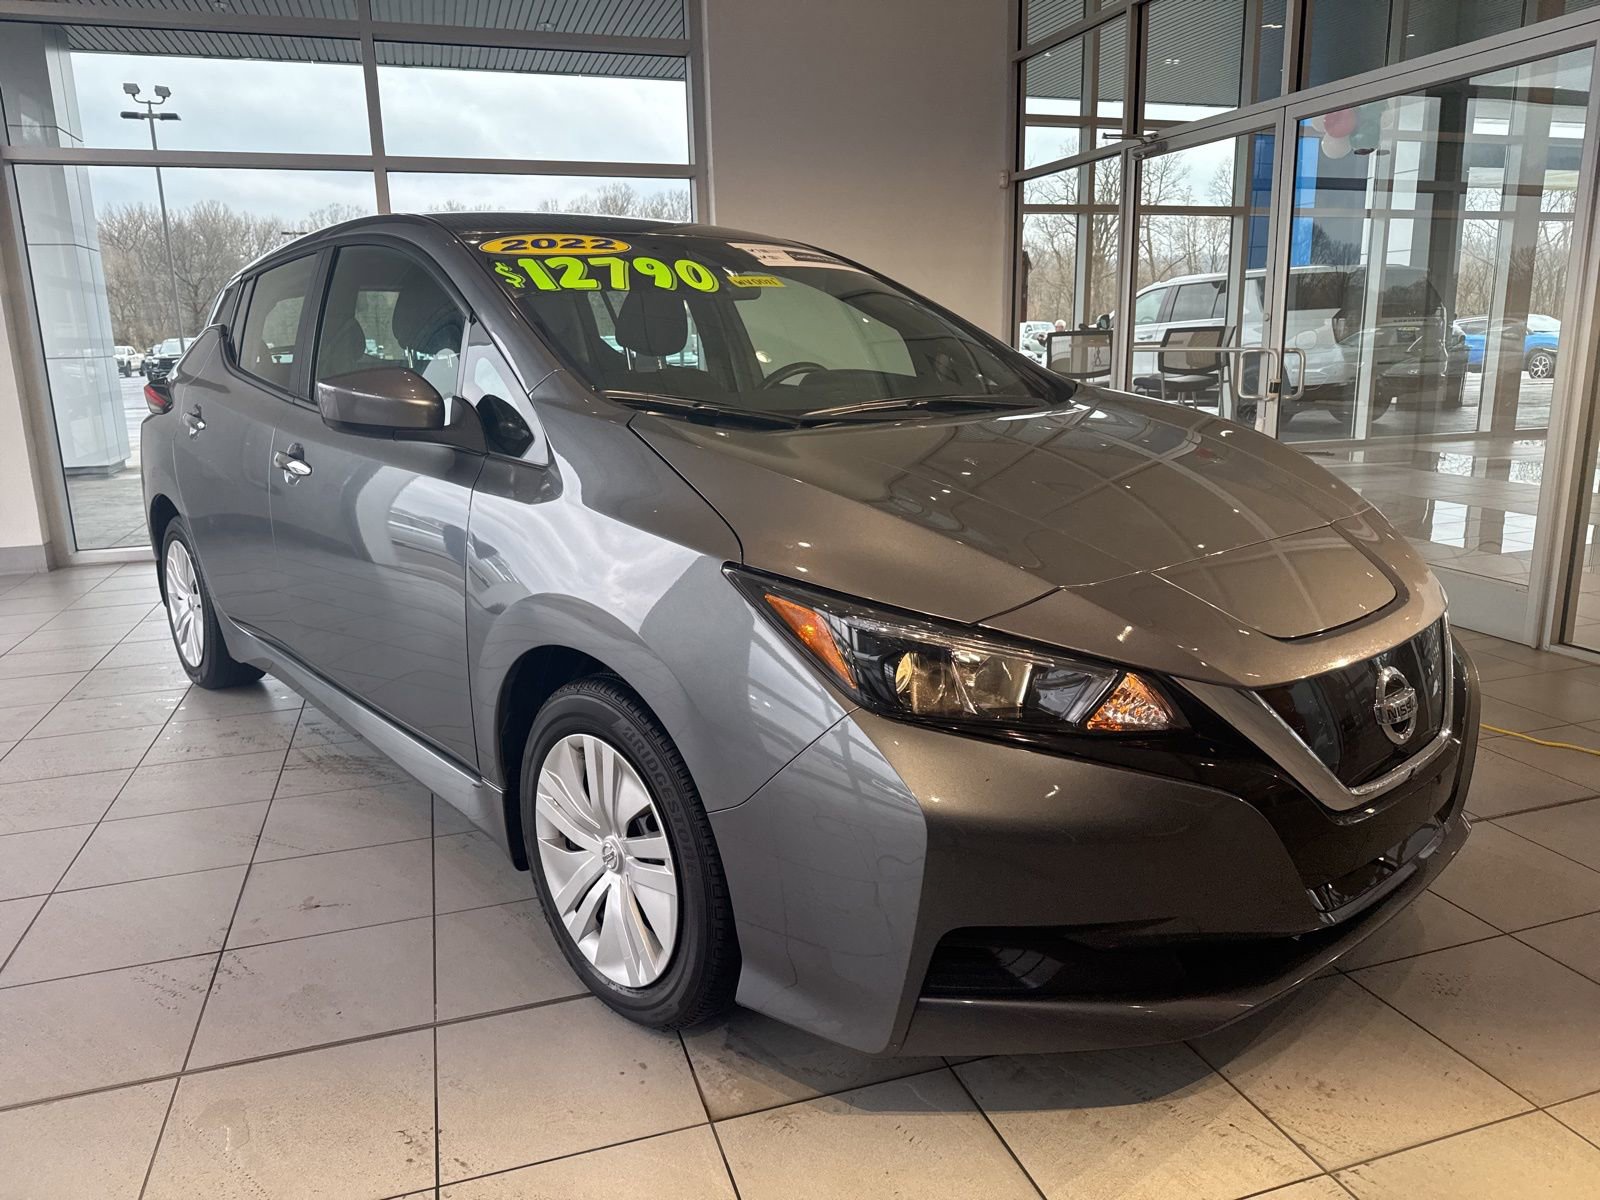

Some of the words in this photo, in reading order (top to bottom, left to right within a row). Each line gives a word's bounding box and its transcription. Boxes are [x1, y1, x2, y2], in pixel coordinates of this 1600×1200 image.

[500, 237, 617, 252] 2022
[494, 256, 720, 292] $12790
[1387, 698, 1415, 720] NISS
[622, 726, 697, 875] BRIDGESTONE
